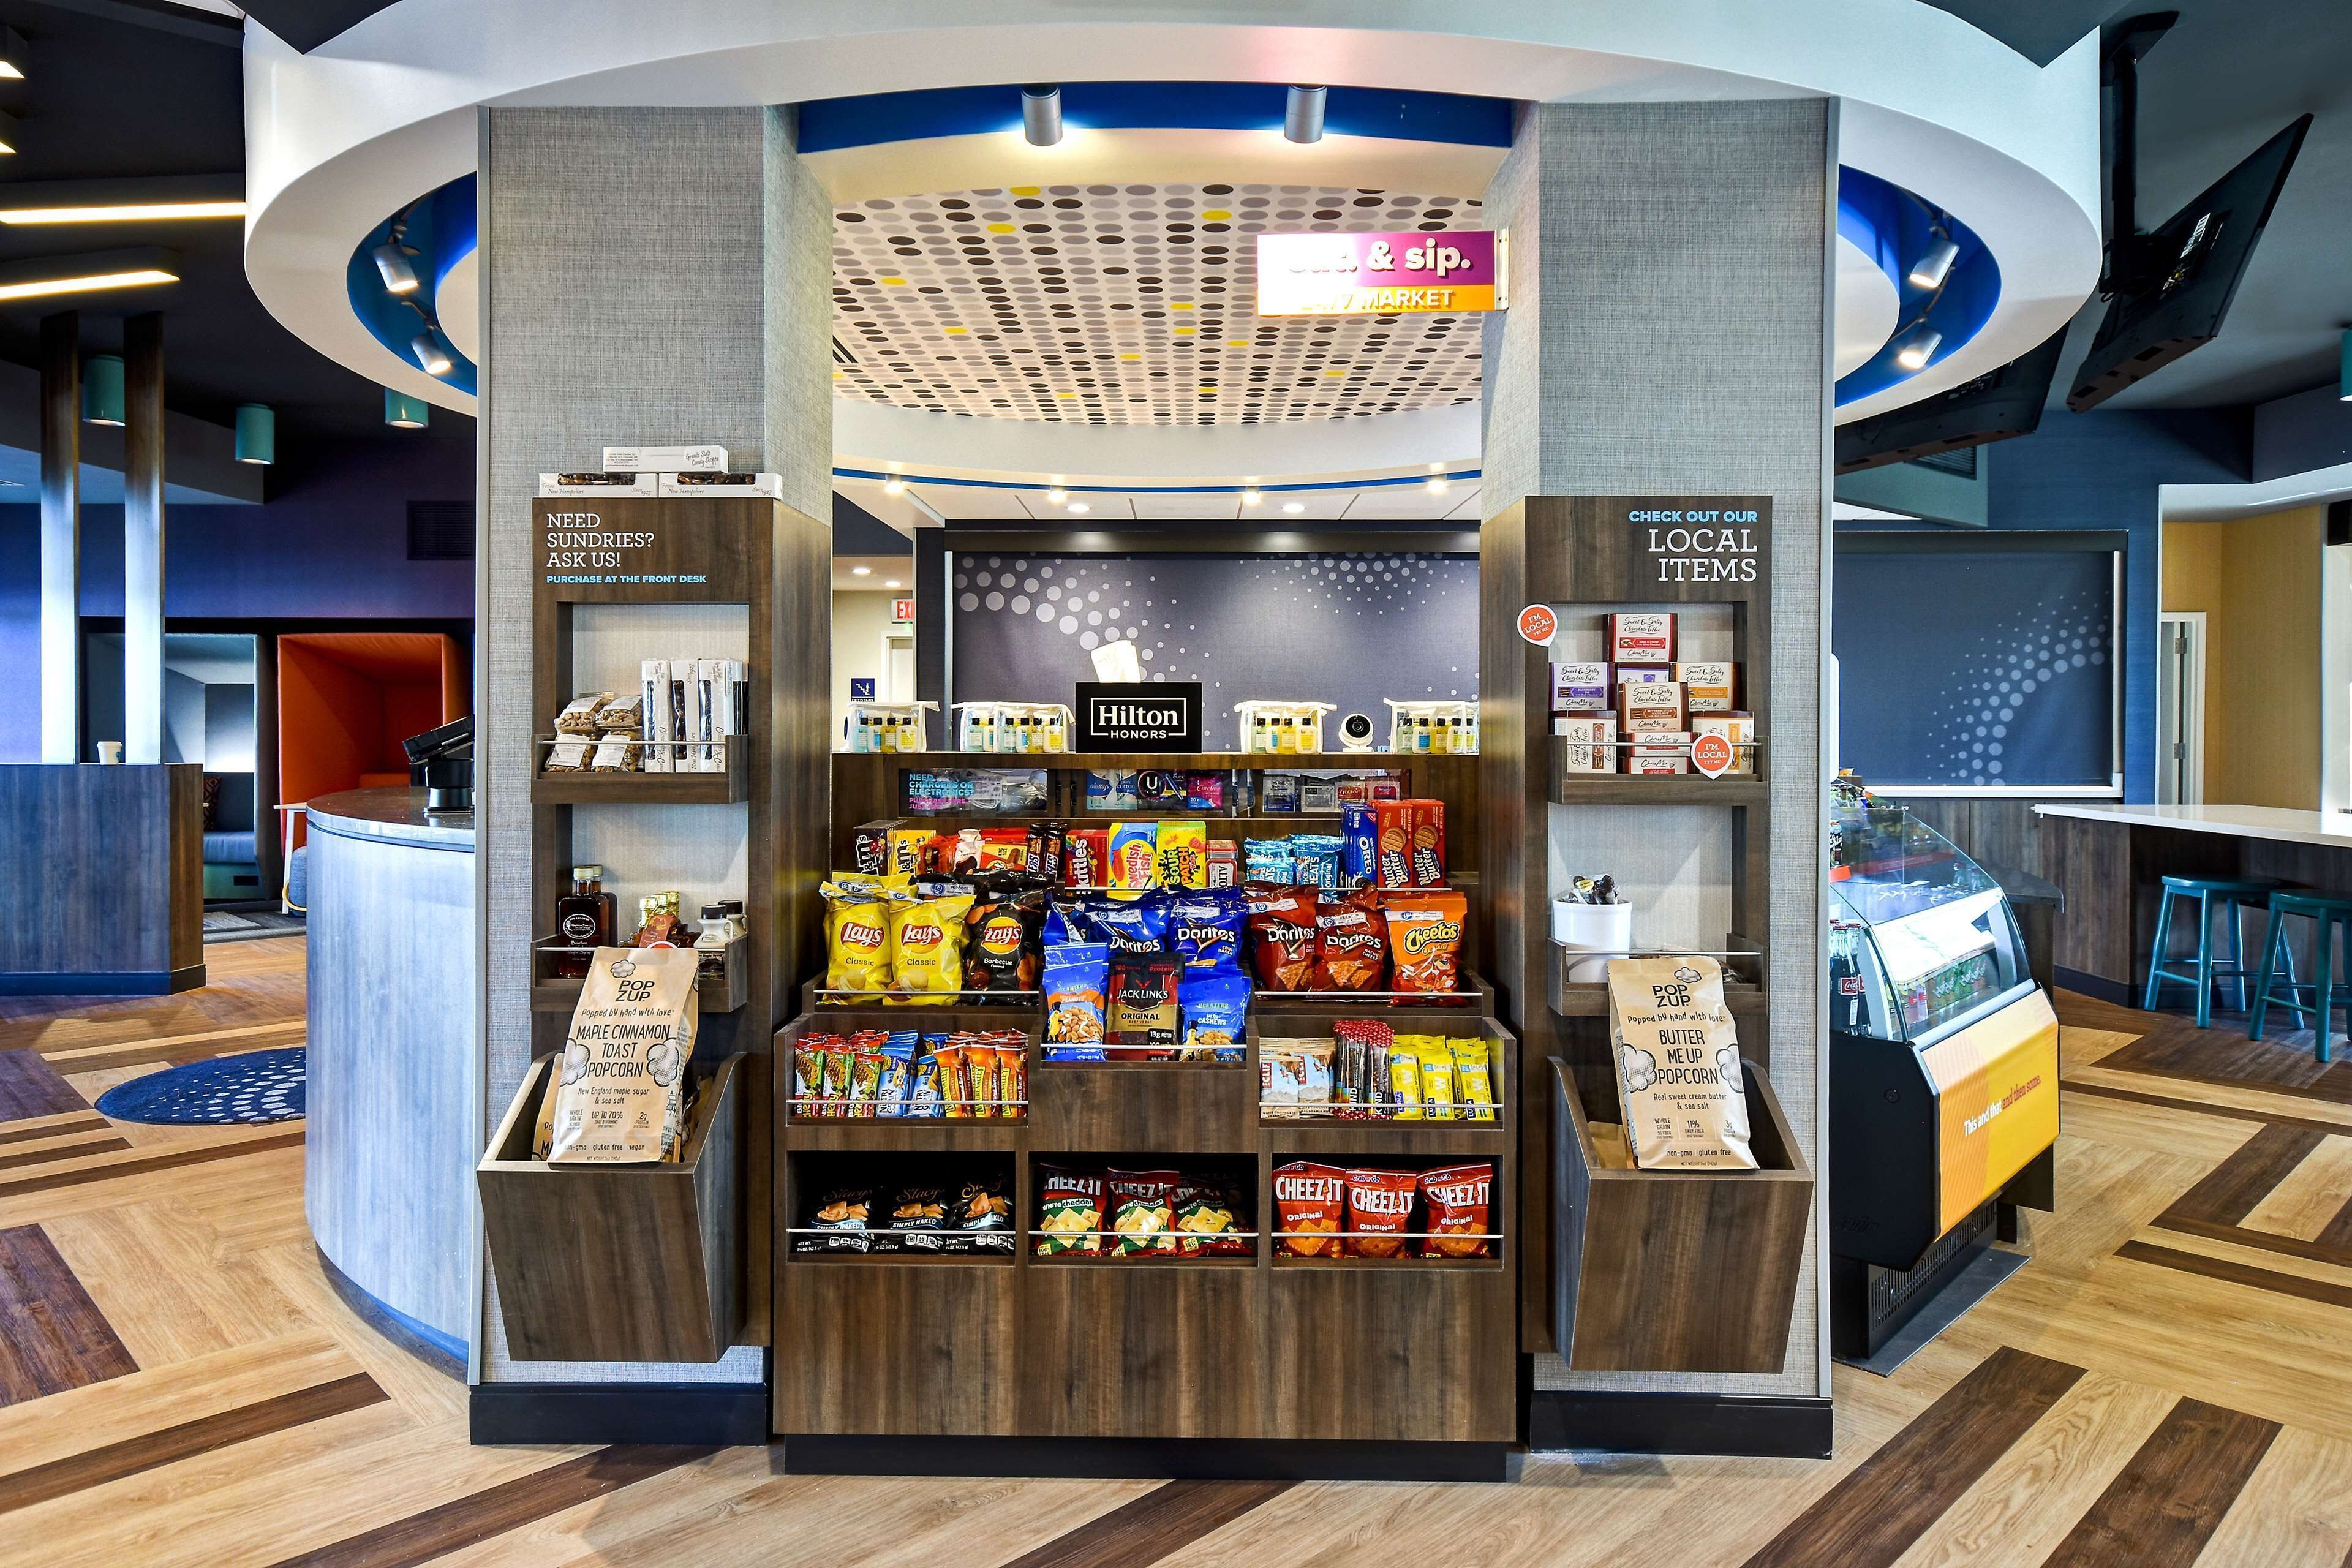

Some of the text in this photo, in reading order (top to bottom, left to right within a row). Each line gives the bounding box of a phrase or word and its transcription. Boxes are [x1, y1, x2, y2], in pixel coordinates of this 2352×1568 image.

[1366, 241, 1395, 271] &
[1405, 238, 1472, 277] sip.
[1362, 290, 1454, 309] MARKET
[546, 513, 600, 528] NEED
[1629, 510, 1758, 522] CHECK OUT OUR
[546, 533, 655, 548] SUNDRIES?
[1648, 529, 1758, 552] LOCAL
[546, 552, 621, 567] ASK US!
[1657, 558, 1758, 582] ITEMS
[546, 575, 707, 584] PURCHASE AT THE FRONT DESK
[897, 601, 914, 619] EXI
[1528, 613, 1542, 624] I'M
[1624, 616, 1663, 628] Sweet Salty
[1524, 618, 1552, 635] LOCAL
[1624, 625, 1647, 633] Chocolate
[1561, 666, 1600, 677] Sweet Salty
[1686, 665, 1724, 676] Sweet Salty
[1561, 674, 1585, 682] Chocolate
[1686, 674, 1709, 683] Chocolate
[1632, 686, 1673, 698] Sweet Salty
[1634, 695, 1657, 704] Chocolate
[1098, 705, 1179, 726] Hilton
[1110, 729, 1167, 739] HONORS
[1147, 776, 1158, 790] U
[1359, 837, 1372, 875] OREO
[1126, 843, 1142, 888] Swedish
[1138, 852, 1153, 880] Fish
[1167, 849, 1180, 884] SOUR
[1178, 846, 1194, 885] PATCH
[1389, 850, 1408, 884] Butter
[1414, 852, 1431, 886] Nutter
[1422, 846, 1441, 881] Butter
[1381, 855, 1399, 888] Nutter
[843, 922, 884, 947] Lay's
[903, 923, 941, 944] Lay's
[984, 925, 1021, 944] Lay's
[1178, 926, 1235, 943] Doritos
[1268, 926, 1315, 943] Doritos
[1404, 922, 1461, 956] Cheetos
[1109, 935, 1161, 953] Doritos
[1327, 933, 1382, 949] Doritos
[1362, 952, 1379, 961] CHEESE
[1364, 948, 1379, 957] NACHO
[845, 957, 875, 967] Classic
[907, 957, 937, 966] Classic
[984, 957, 1013, 966] Barbecue
[619, 980, 655, 990] POP
[1651, 984, 1688, 996] POP
[615, 990, 650, 1002] ZUP
[1118, 989, 1169, 999] JACK LINK'S
[1654, 995, 1692, 1008] ZUP
[581, 1008, 608, 1019] Popped
[608, 1009, 619, 1017] by
[619, 1008, 637, 1017] hand
[1627, 1014, 1656, 1025] Popped
[1657, 1012, 1667, 1022] by
[1670, 1011, 1687, 1022] hand
[1689, 1011, 1706, 1021] with
[576, 1024, 671, 1040] MAPLE CINNAMON
[1659, 1030, 1706, 1046] BUTTER
[601, 1042, 639, 1058] TOAST
[1667, 1048, 1703, 1064] ME UP
[587, 1062, 644, 1078] POPCORN
[1657, 1068, 1719, 1085] POPCORN
[591, 1087, 612, 1096] England
[632, 1088, 650, 1096] sugar
[608, 1111, 624, 1120] 70%
[639, 1112, 647, 1121] 2g
[1964, 1083, 2026, 1137] This and that and then
[592, 1143, 610, 1152] gluten
[1042, 1198, 1093, 1211] WHITE cheddar
[1117, 1199, 1164, 1213] WHITE cheddar
[1178, 1201, 1198, 1214] WHITE
[892, 1219, 914, 1229] SIMPLY
[962, 1219, 984, 1229] SIMPLY
